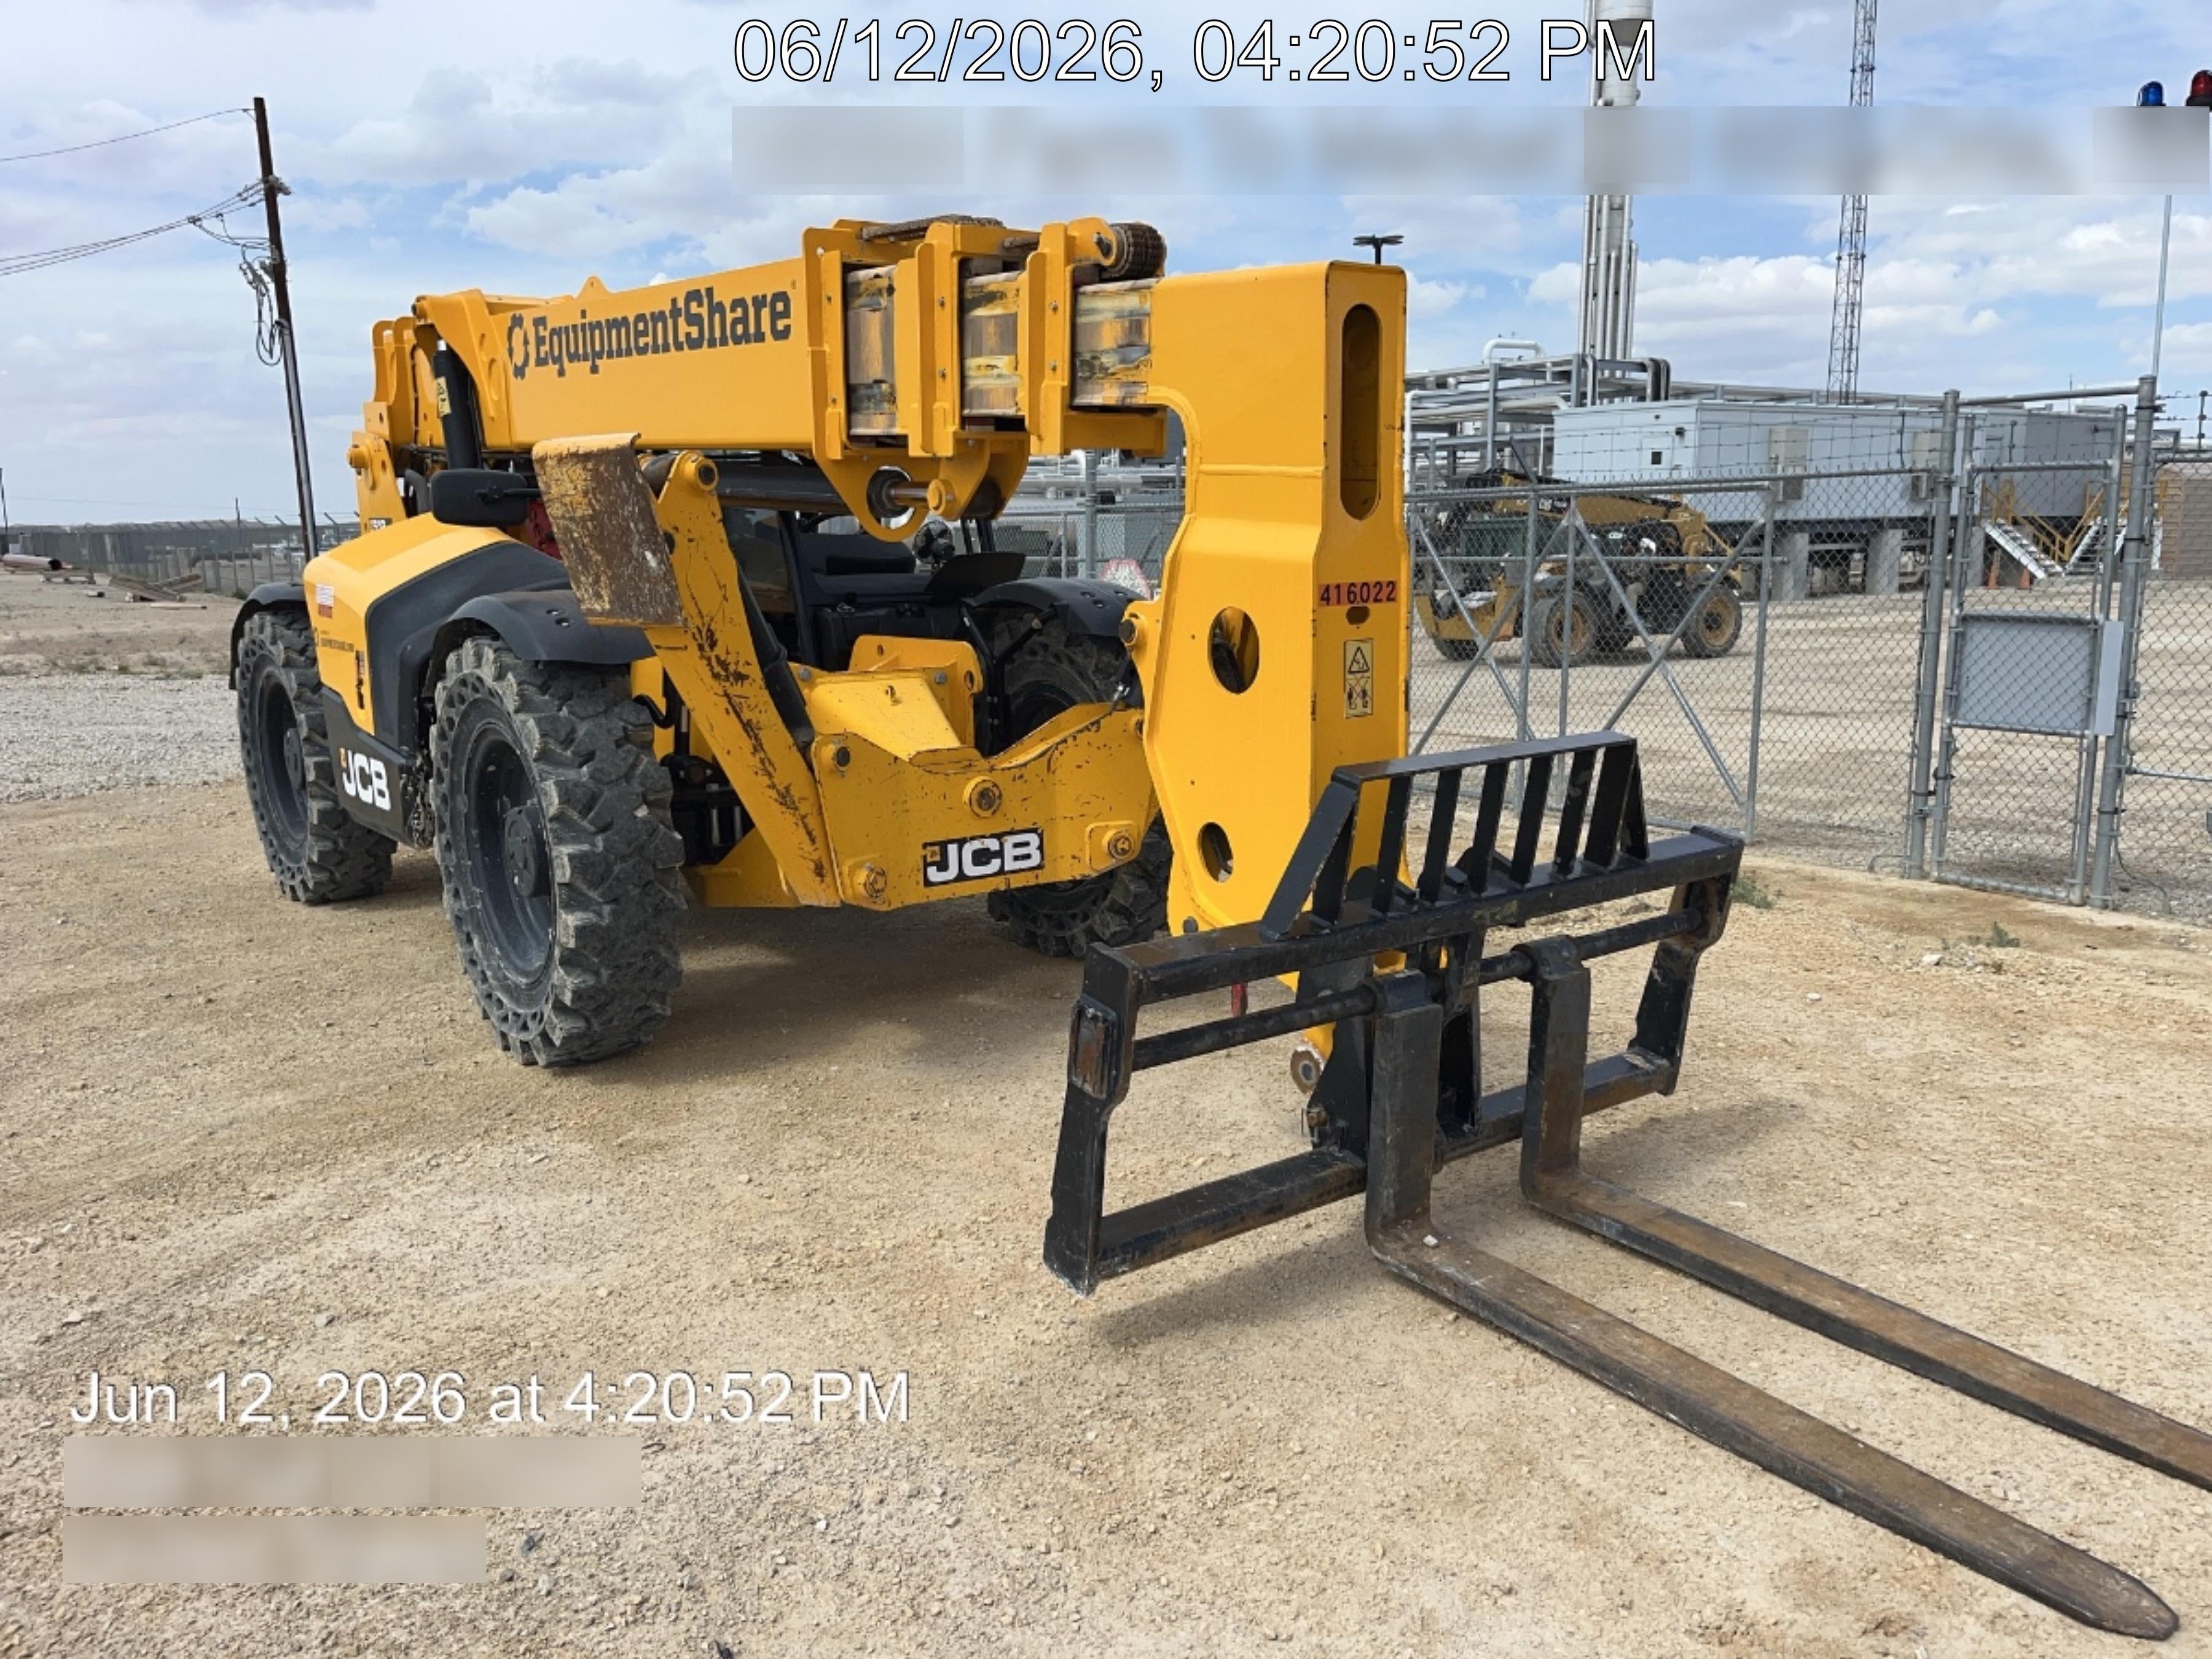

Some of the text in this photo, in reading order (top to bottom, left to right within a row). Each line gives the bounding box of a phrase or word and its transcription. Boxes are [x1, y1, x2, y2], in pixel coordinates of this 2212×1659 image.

[532, 286, 791, 377] EquipmentShare
[1320, 580, 1396, 605] 416022
[342, 750, 391, 811] JCB
[927, 833, 1042, 882] JCB
